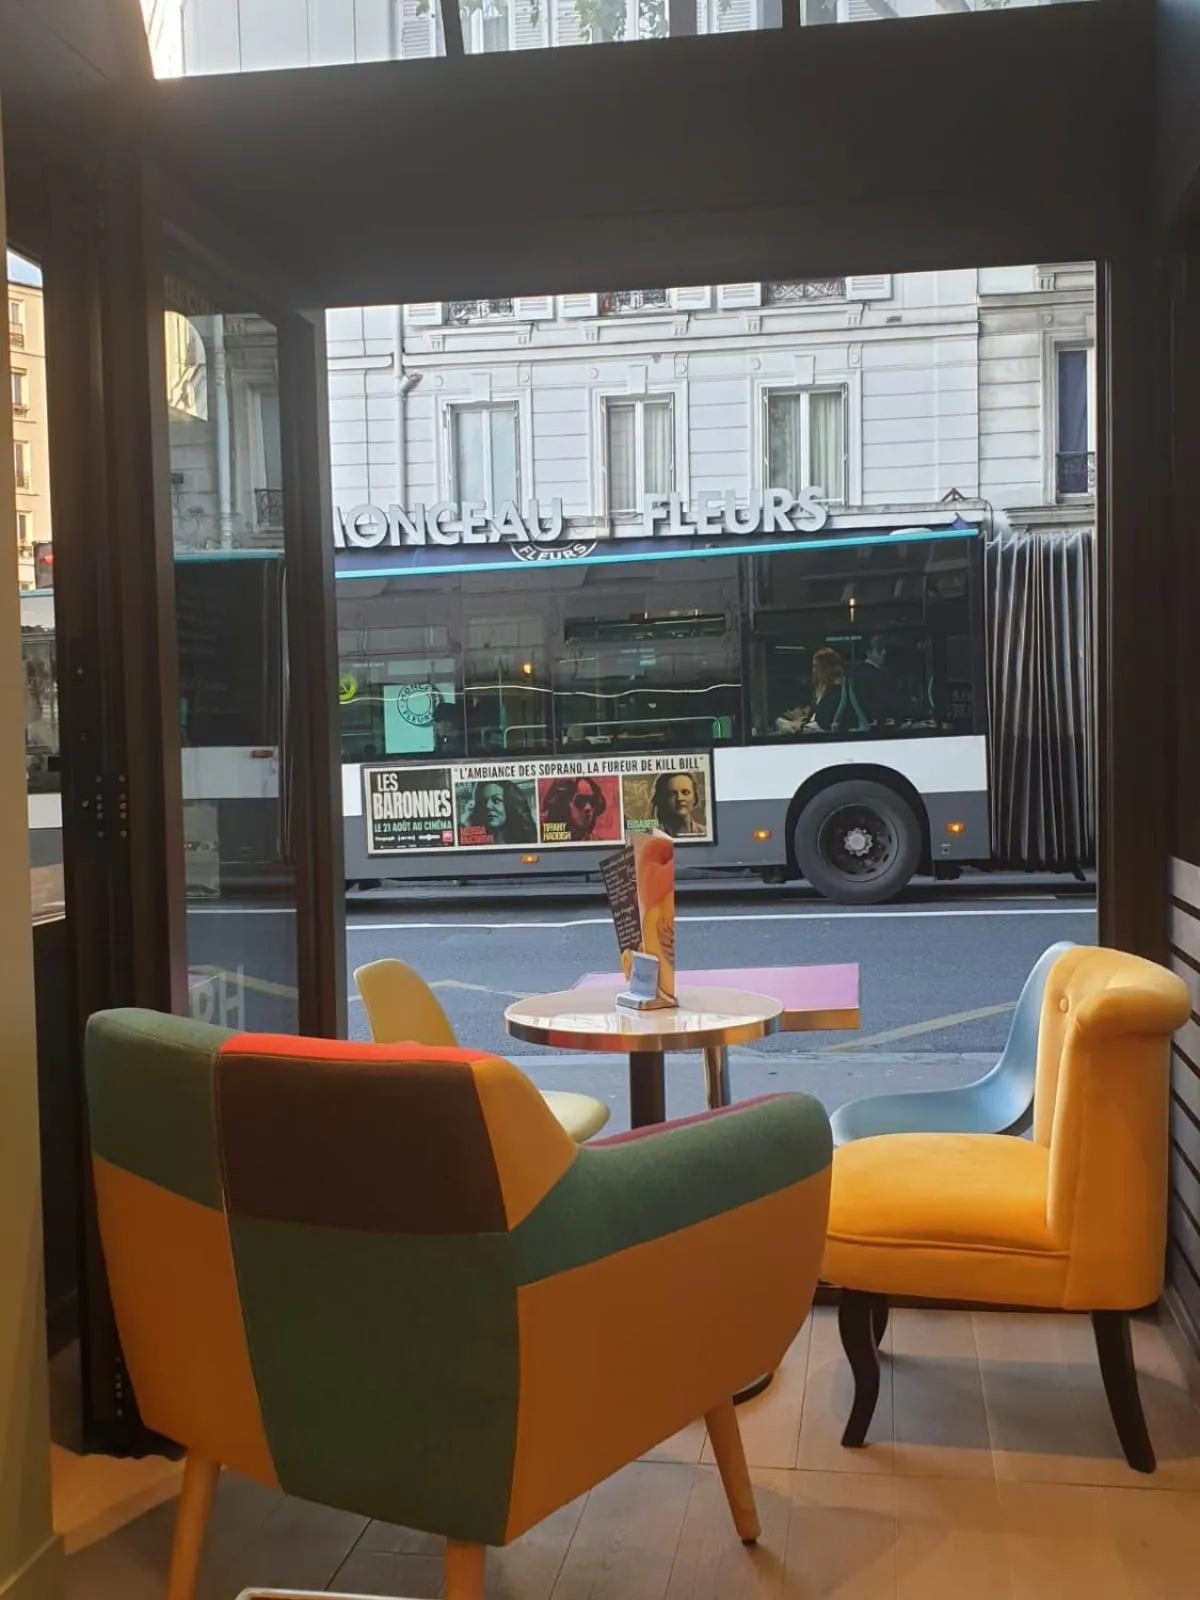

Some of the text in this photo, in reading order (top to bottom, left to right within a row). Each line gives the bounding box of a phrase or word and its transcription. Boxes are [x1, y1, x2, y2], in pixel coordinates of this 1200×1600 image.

[335, 486, 829, 548] ONCEAU FLEURS
[519, 543, 587, 560] FLEURS
[519, 764, 536, 777] DES
[539, 761, 585, 776] SOPRANO,
[588, 761, 599, 774] LA
[602, 759, 638, 773] FUREUR
[641, 759, 652, 771] DE
[656, 757, 676, 771] KILL
[377, 773, 398, 792] LES
[373, 789, 452, 820] BARONNES
[374, 823, 382, 832] LE
[383, 823, 391, 832] 21
[412, 821, 423, 831] AU
